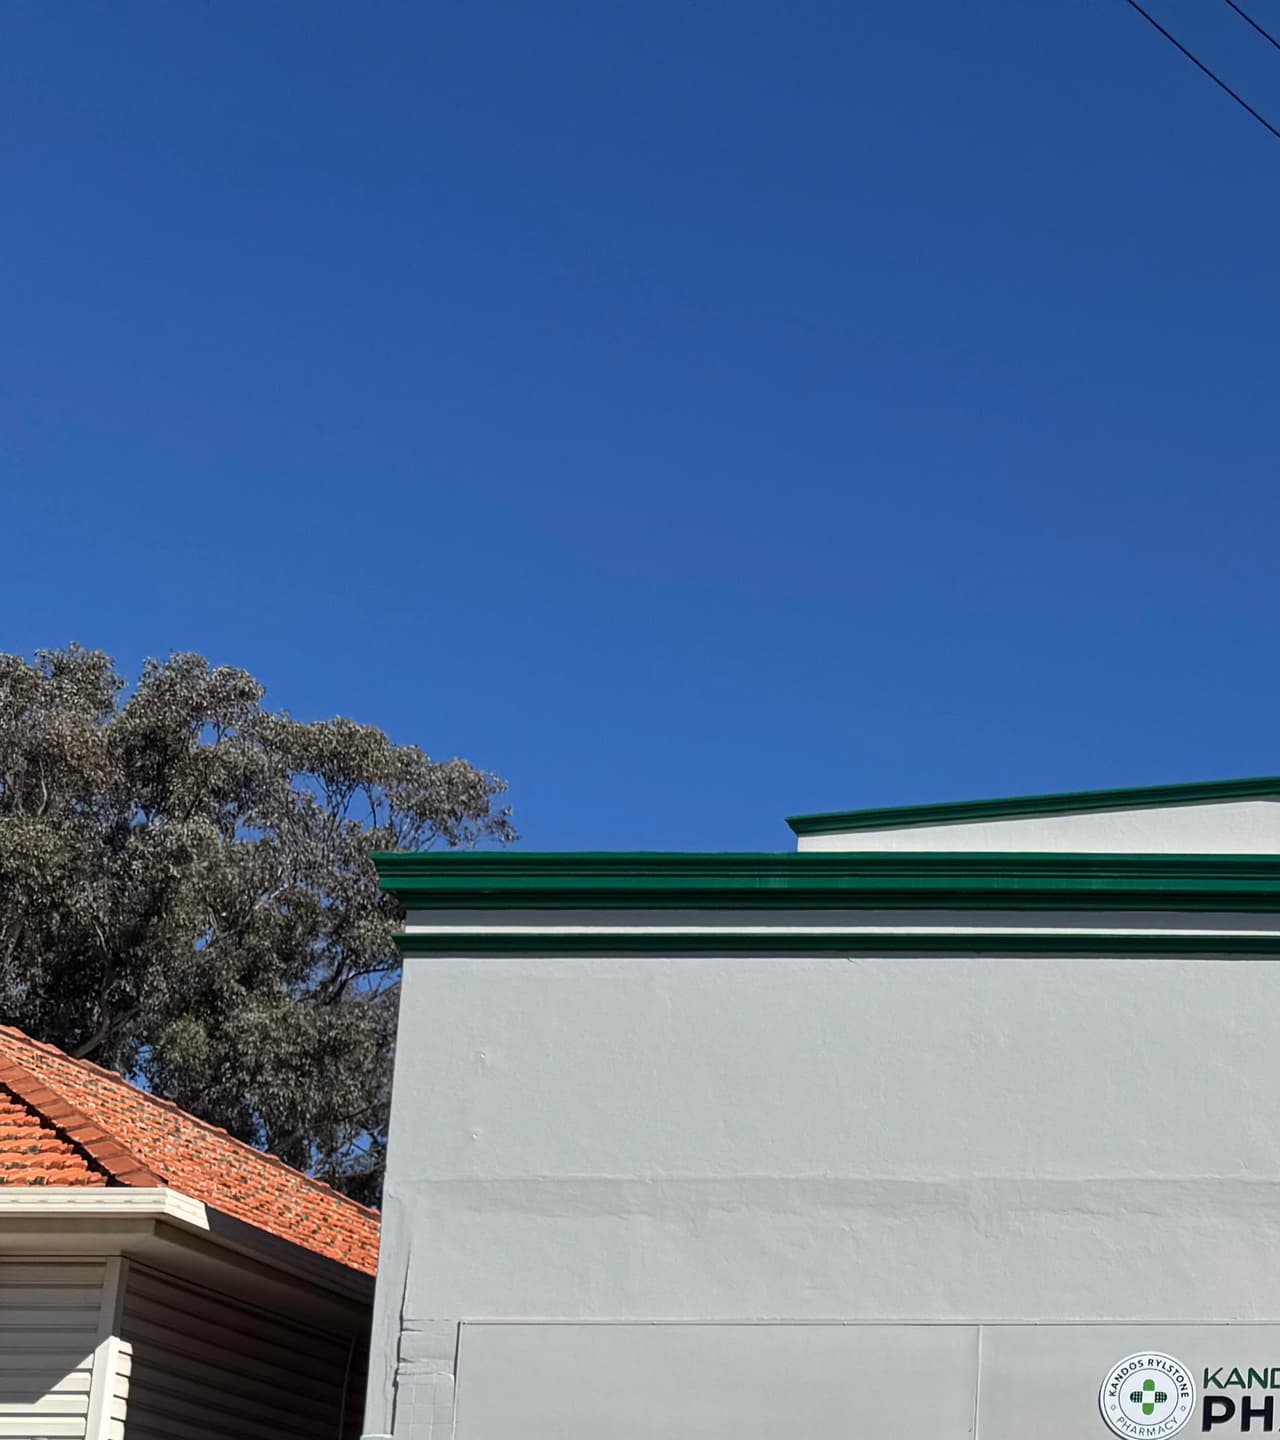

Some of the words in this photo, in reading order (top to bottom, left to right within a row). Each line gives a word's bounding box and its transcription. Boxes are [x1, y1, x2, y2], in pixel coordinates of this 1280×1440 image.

[1108, 1360, 1145, 1397] KANDOS
[1148, 1359, 1189, 1398] RYLSTONE
[1115, 1416, 1179, 1437] PHARMACY
